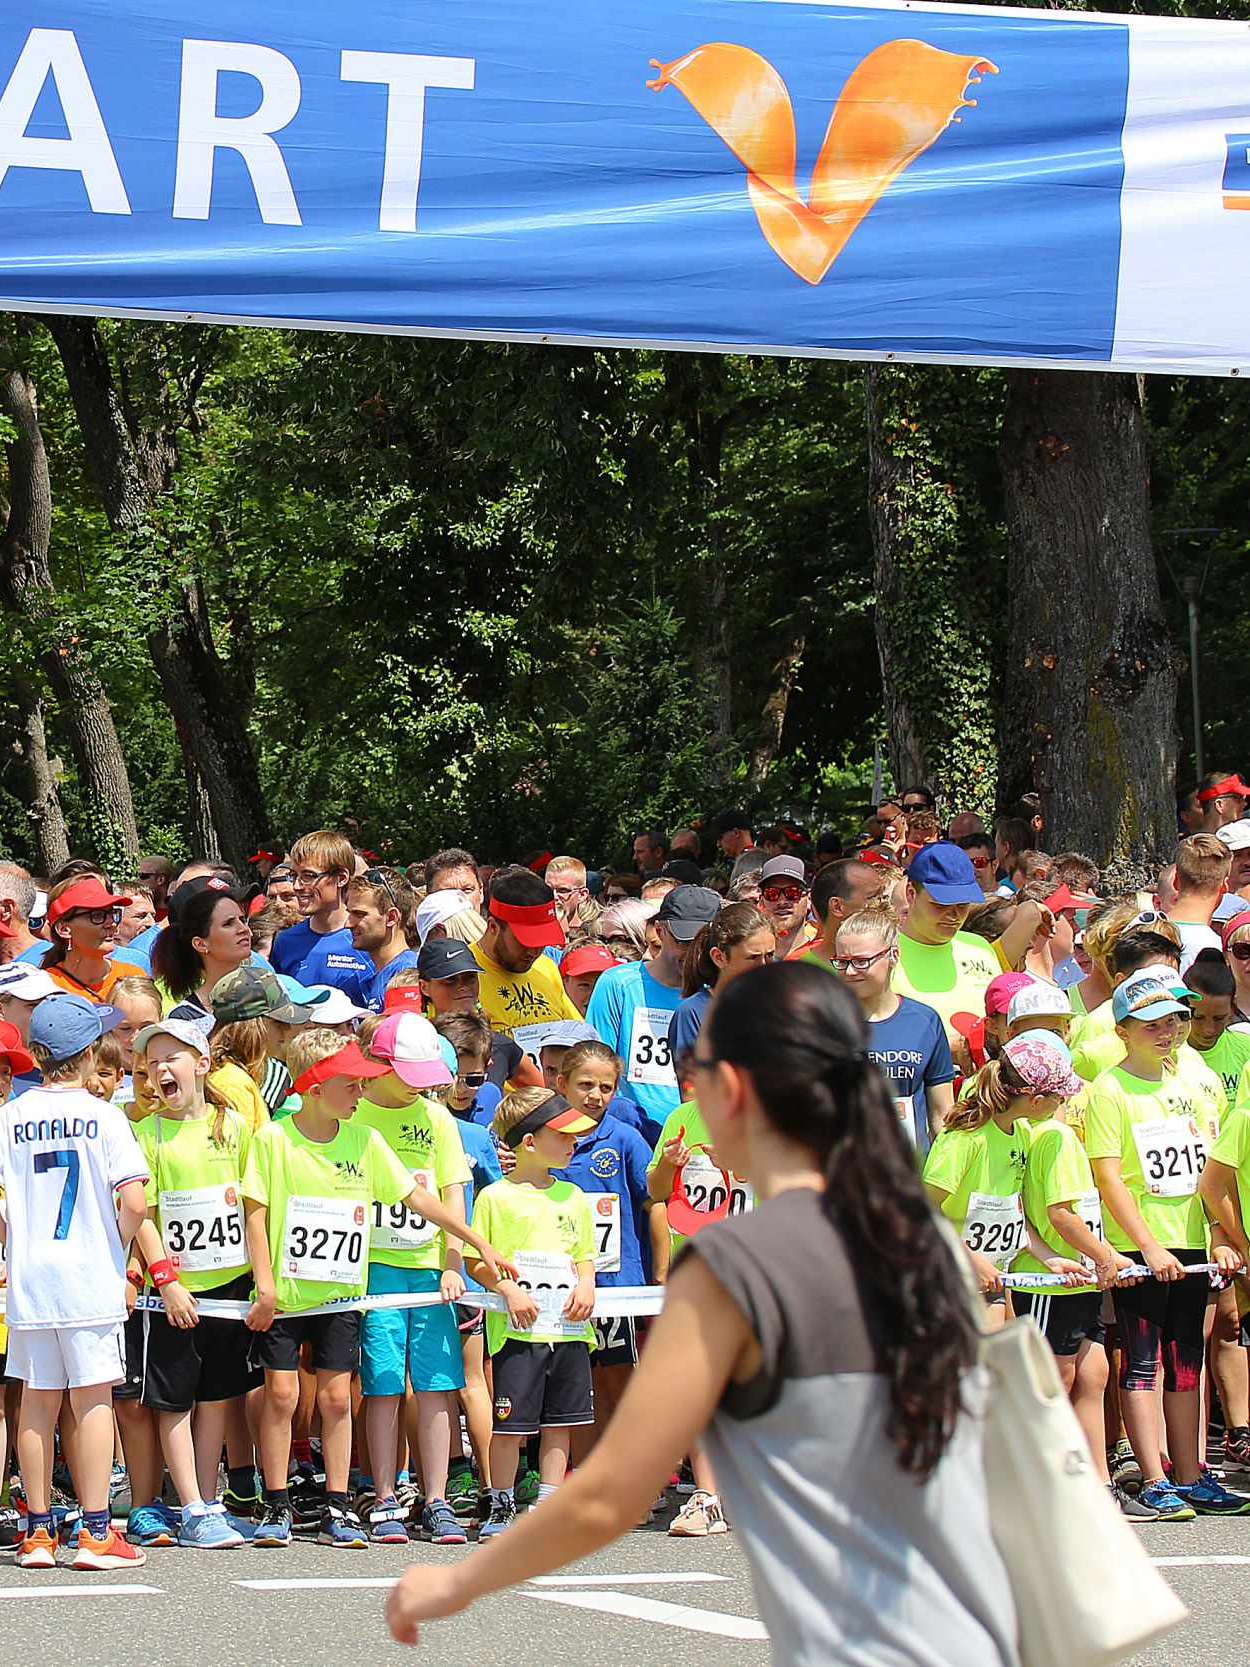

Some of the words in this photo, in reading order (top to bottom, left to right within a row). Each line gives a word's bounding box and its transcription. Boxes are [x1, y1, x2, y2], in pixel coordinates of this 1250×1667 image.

[326, 960, 366, 971] Automotive
[327, 954, 356, 963] Mentor
[636, 1035, 671, 1067] 33
[868, 1050, 923, 1065] ENDORF
[14, 1117, 98, 1144] RONALDO
[1146, 1143, 1207, 1180] 3215
[34, 1150, 80, 1241] 7
[293, 1200, 323, 1209] Stadtlauf
[372, 1200, 427, 1230] 195
[167, 1213, 242, 1253] 3245
[289, 1226, 363, 1264] 3270
